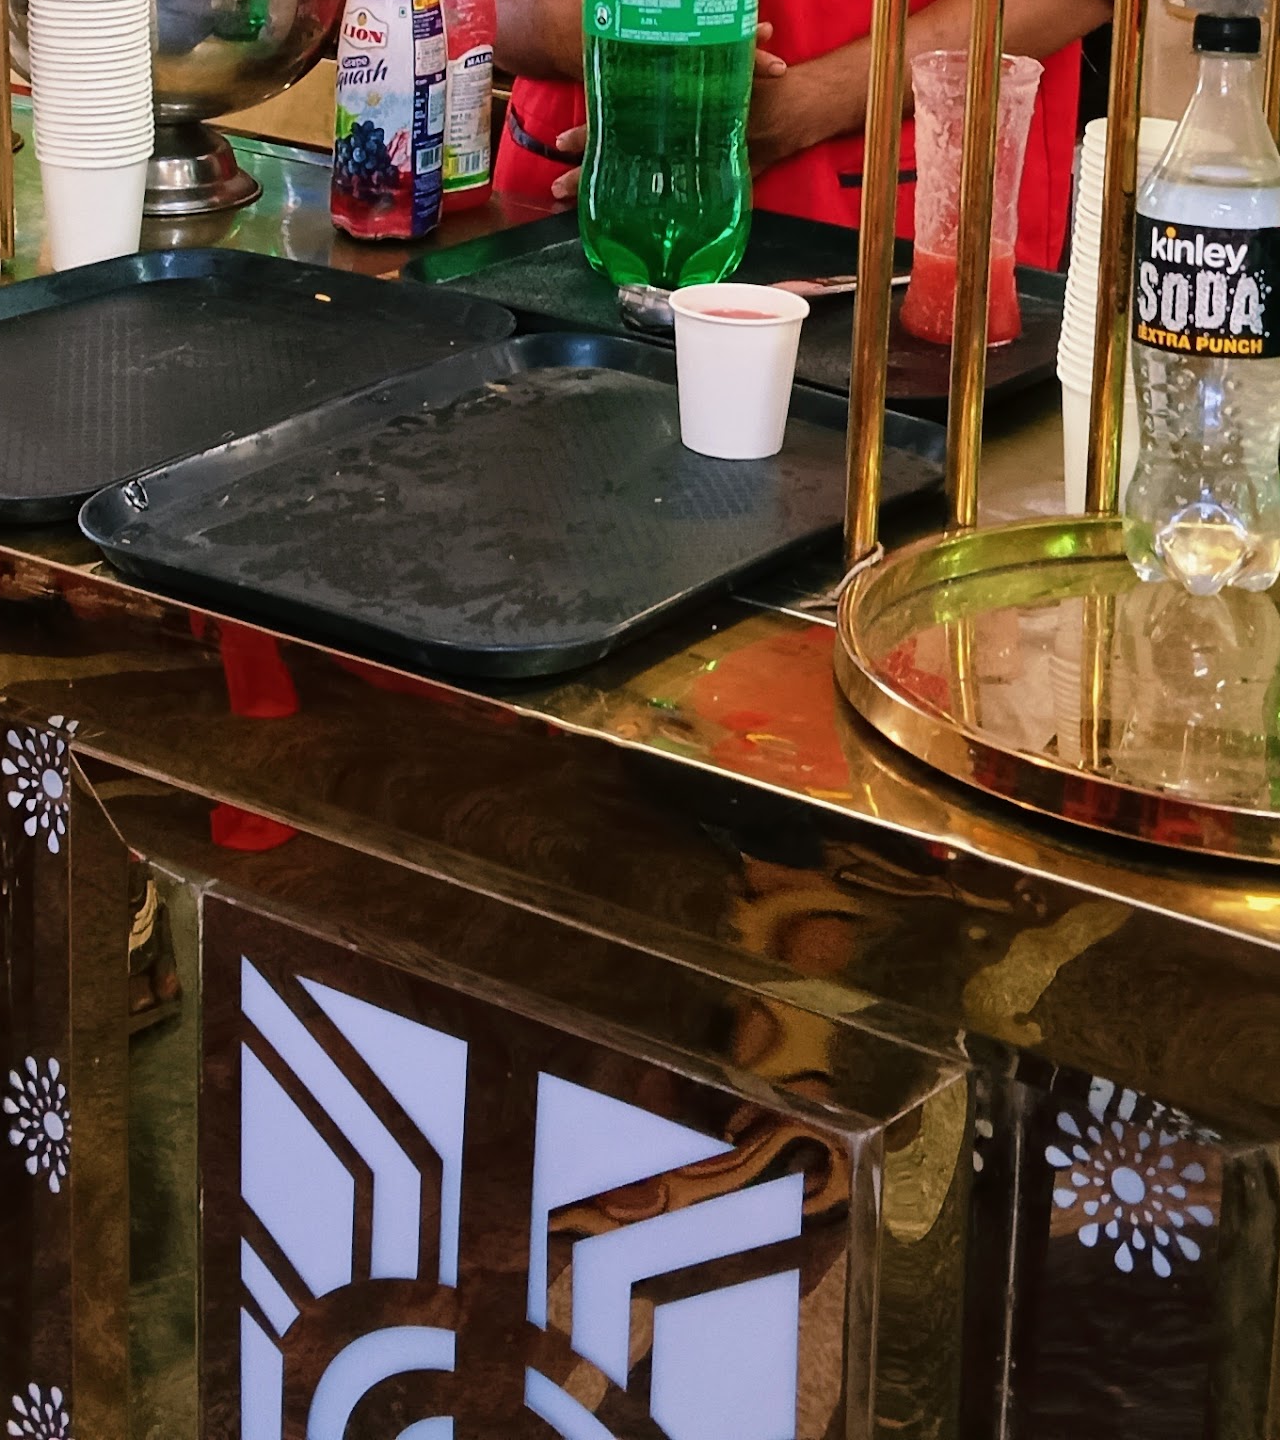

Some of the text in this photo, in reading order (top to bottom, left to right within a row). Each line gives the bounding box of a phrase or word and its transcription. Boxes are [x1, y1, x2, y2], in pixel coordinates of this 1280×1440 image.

[345, 23, 383, 44] LION
[337, 58, 388, 92] quash
[1151, 227, 1248, 274] kinley
[1138, 261, 1267, 335] SODA
[1196, 336, 1263, 354] PUNCH
